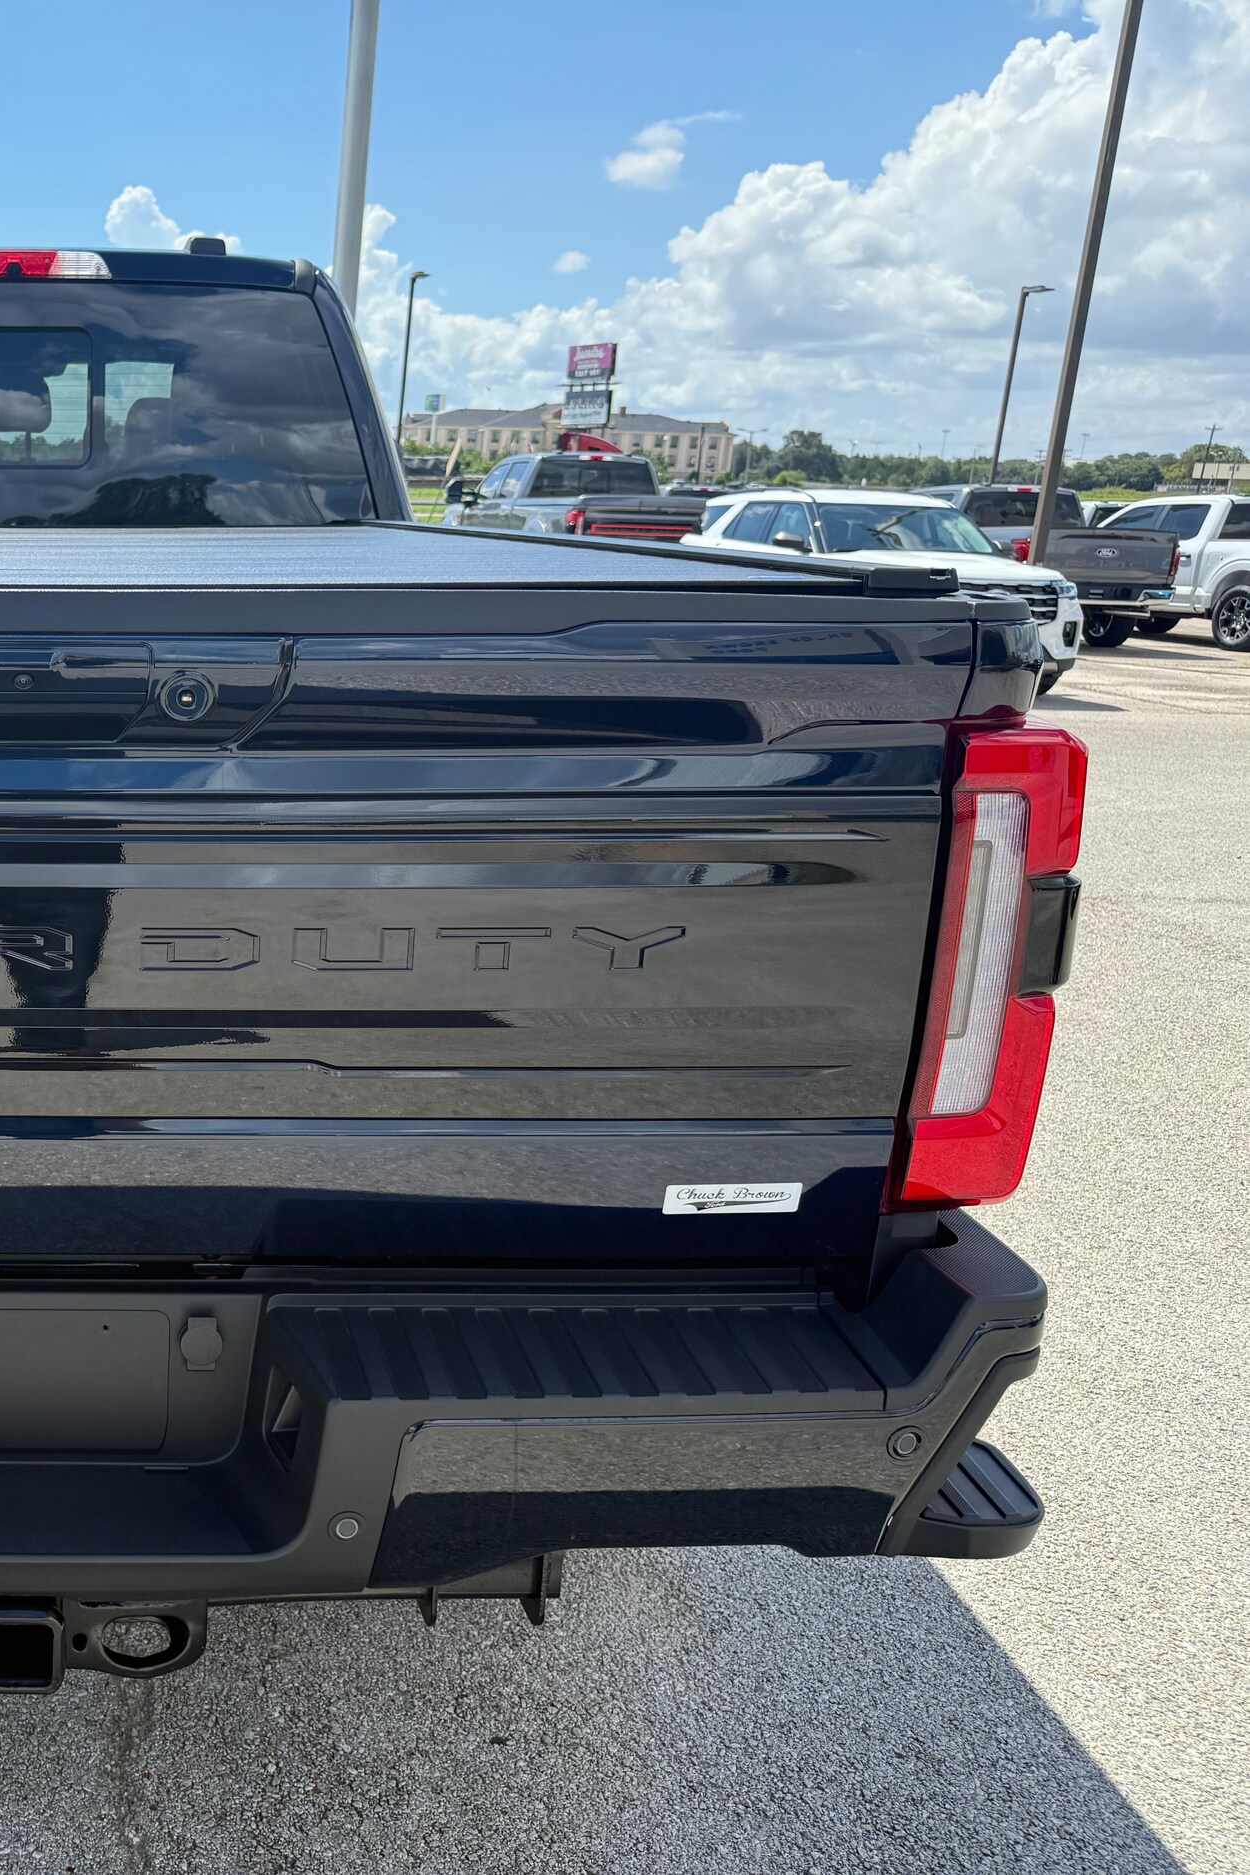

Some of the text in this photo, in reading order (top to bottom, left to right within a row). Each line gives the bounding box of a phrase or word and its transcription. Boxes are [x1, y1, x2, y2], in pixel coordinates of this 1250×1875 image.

[139, 924, 686, 972] DUTY
[676, 1186, 790, 1200] Chuck Brown
[704, 1200, 726, 1209] Ford
